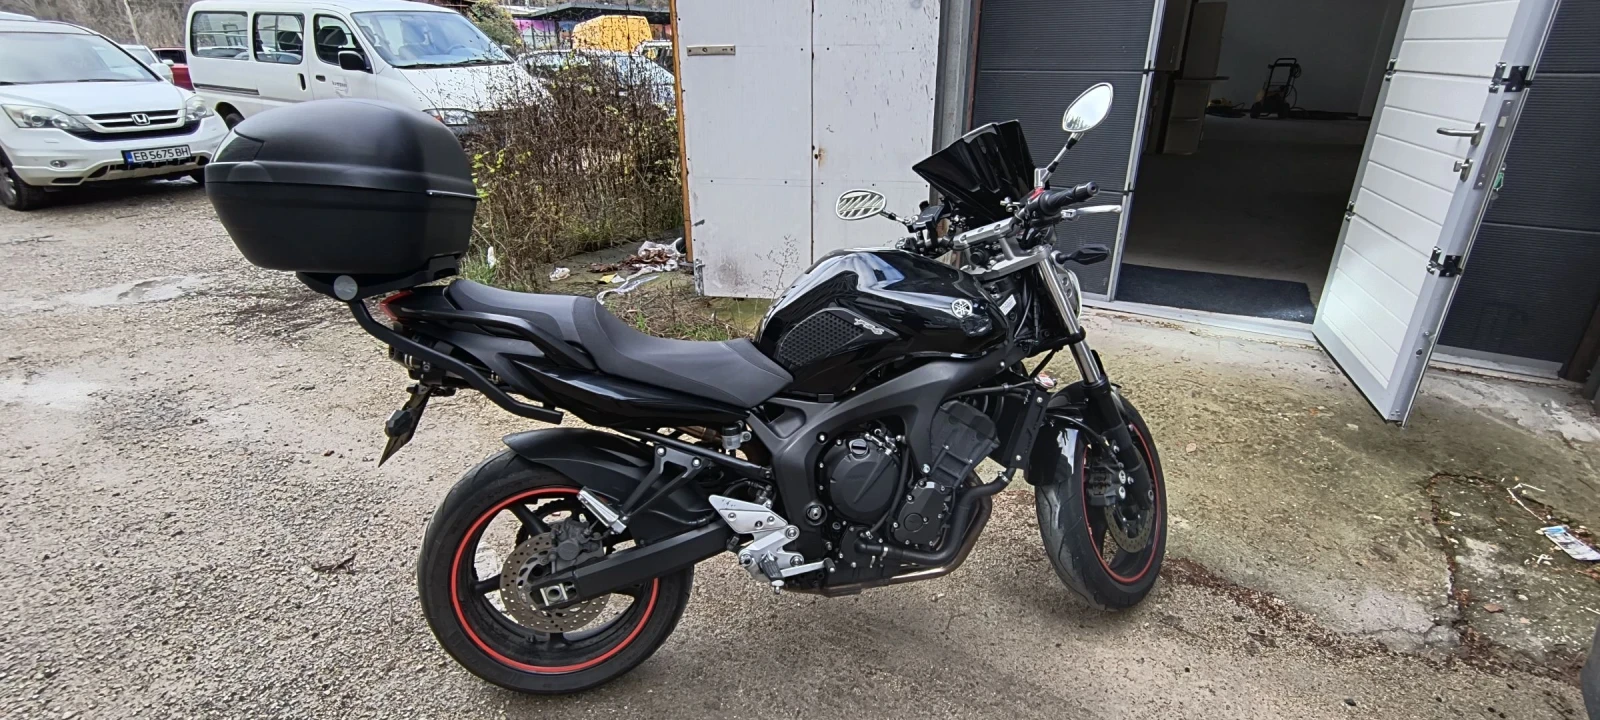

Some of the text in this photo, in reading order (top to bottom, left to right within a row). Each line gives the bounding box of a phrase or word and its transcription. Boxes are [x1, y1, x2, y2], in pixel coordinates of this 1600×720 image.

[133, 147, 189, 161] EB 5675 BH
